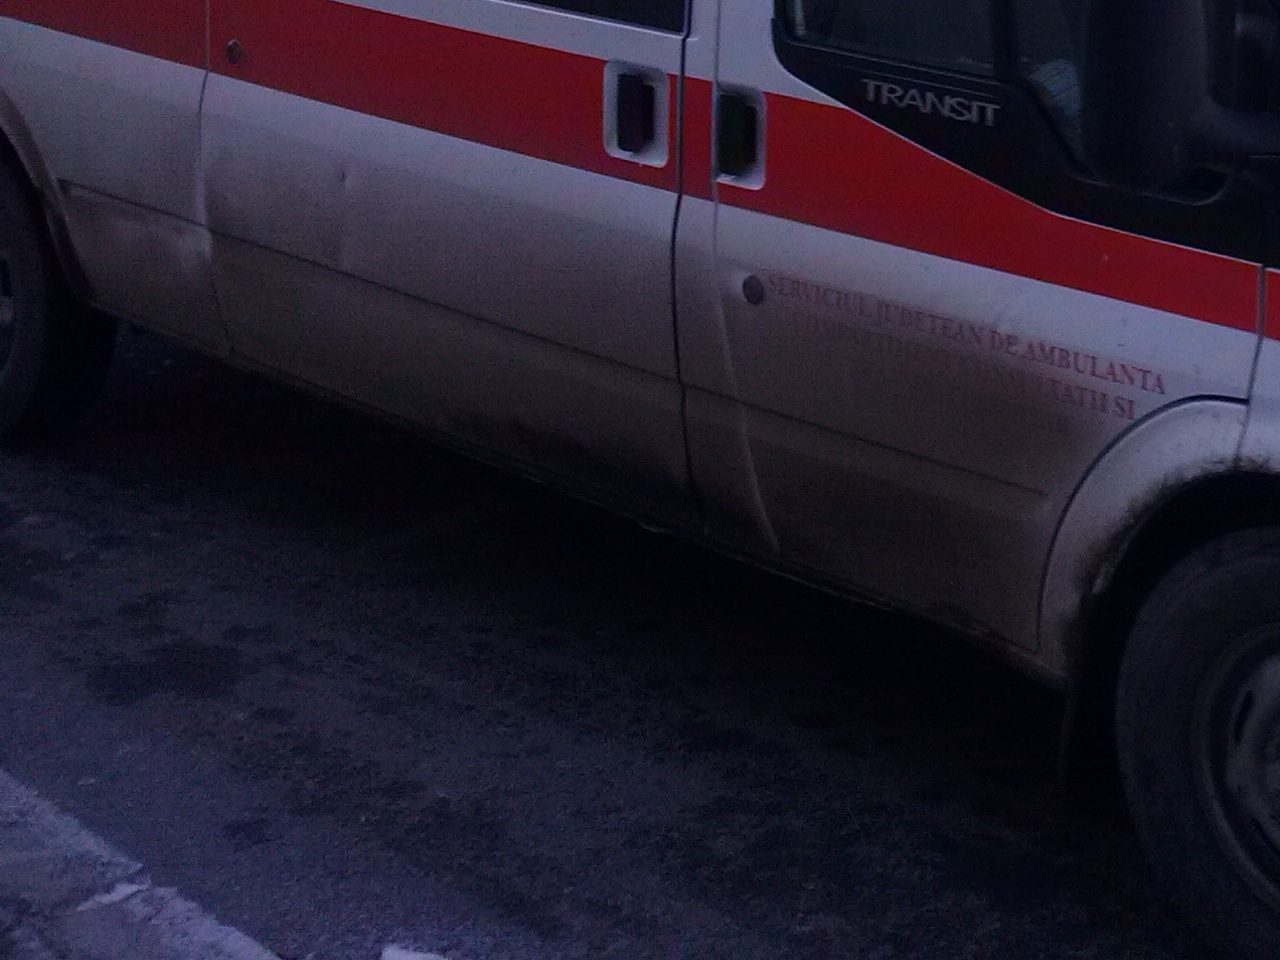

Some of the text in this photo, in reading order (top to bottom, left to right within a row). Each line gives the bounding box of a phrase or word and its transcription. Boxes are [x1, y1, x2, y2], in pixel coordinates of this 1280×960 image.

[861, 78, 1001, 127] TRANSIT
[767, 273, 1167, 395] SERVICIUL JUDETEAN DE AMBULANTA
[1113, 396, 1136, 421] SI
